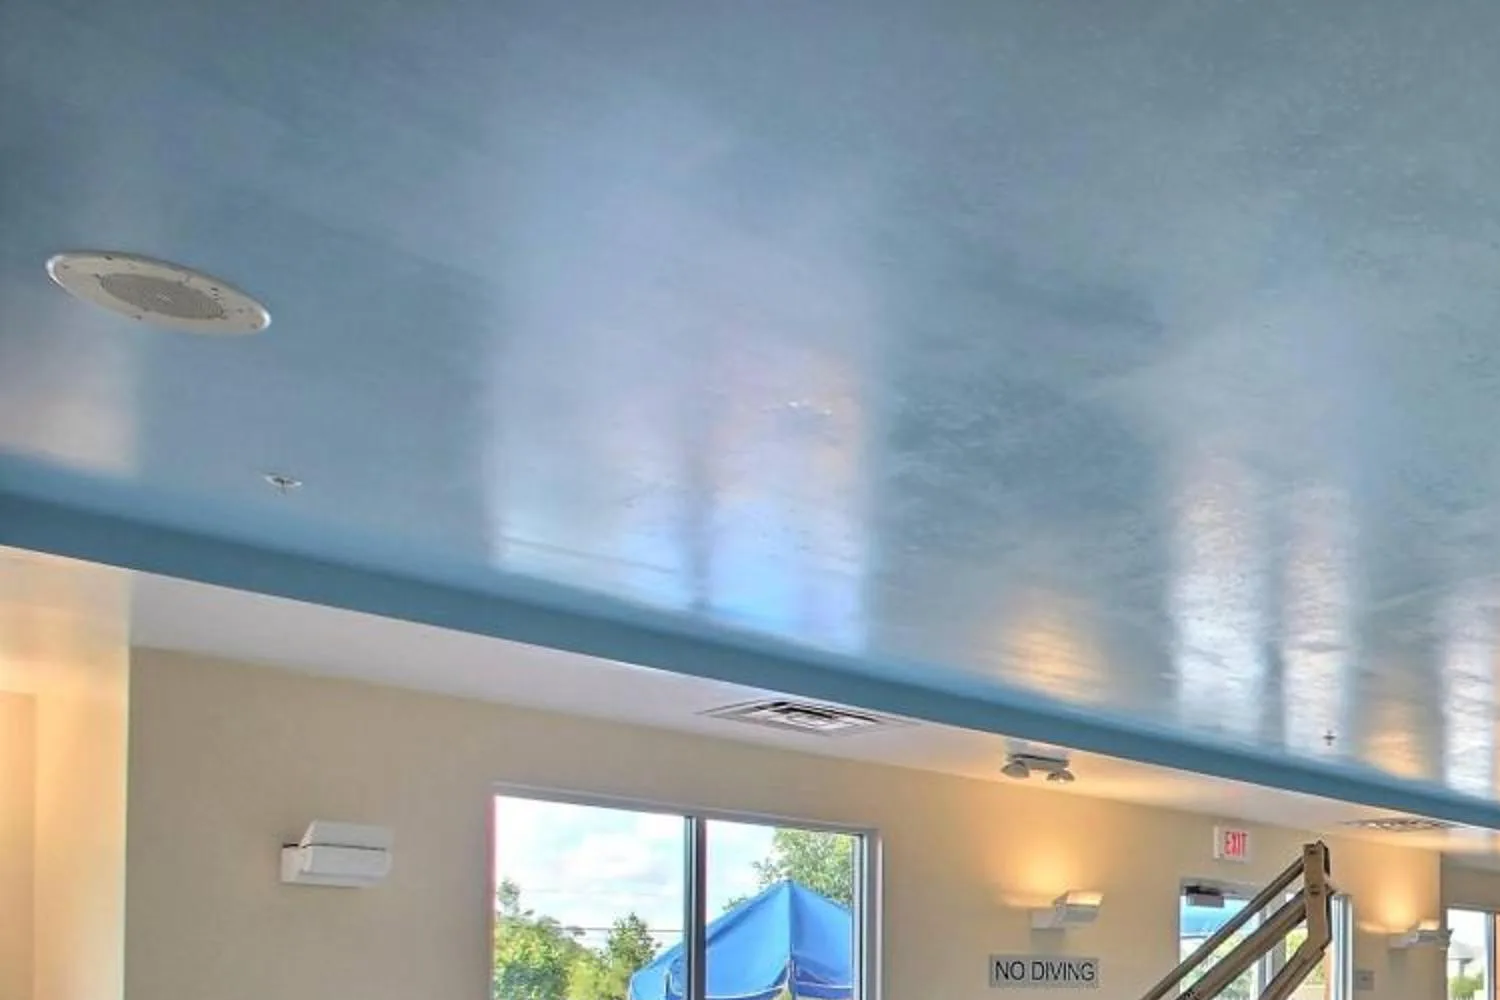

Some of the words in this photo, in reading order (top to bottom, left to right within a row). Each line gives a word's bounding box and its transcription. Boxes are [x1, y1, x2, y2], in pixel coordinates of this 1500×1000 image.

[1224, 831, 1248, 856] EXIT
[995, 960, 1025, 981] NO
[1031, 960, 1095, 982] DIVING
